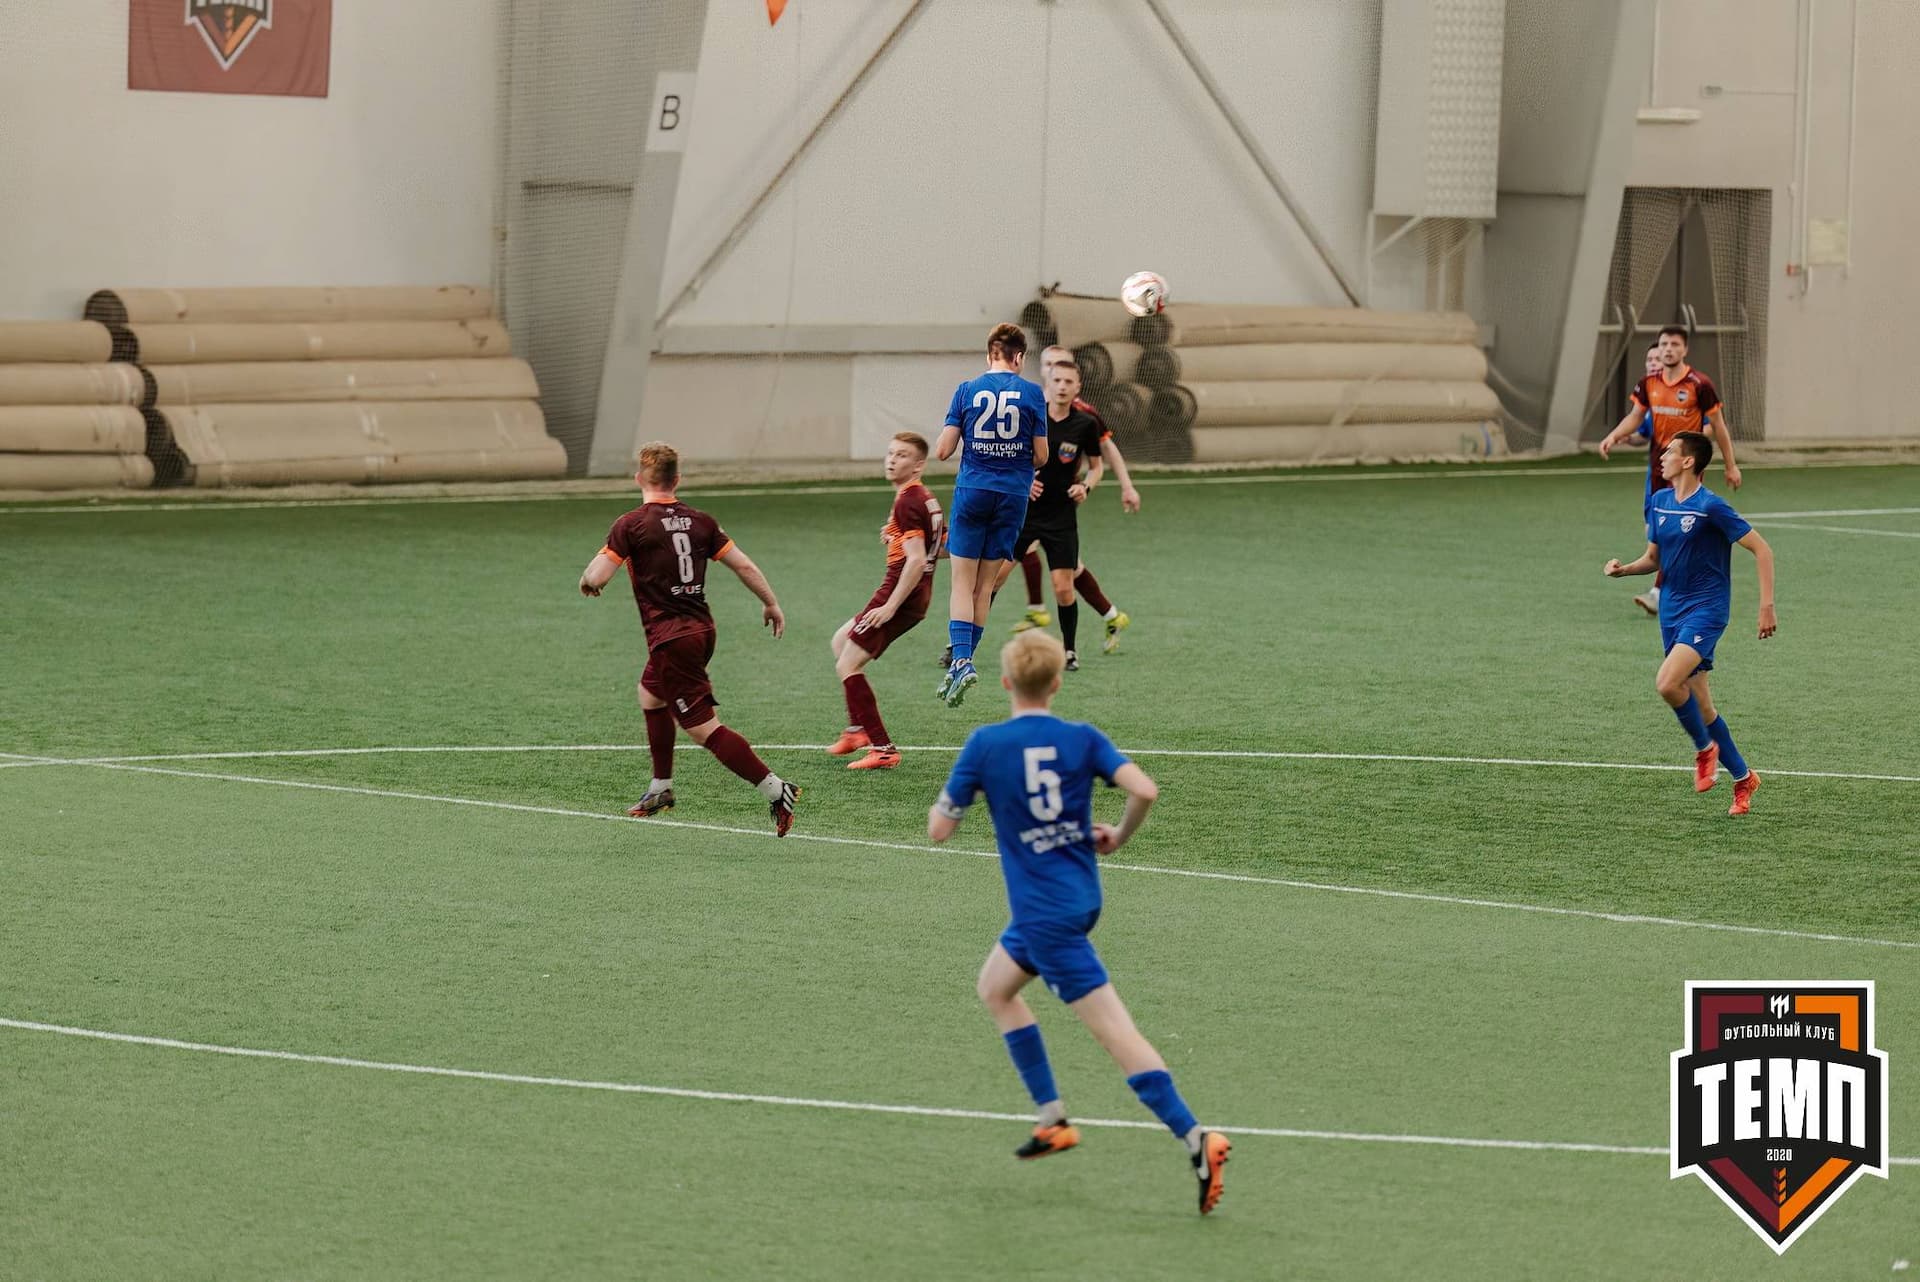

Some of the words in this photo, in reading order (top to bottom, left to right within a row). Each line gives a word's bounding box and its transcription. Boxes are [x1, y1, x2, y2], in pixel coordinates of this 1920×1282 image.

[972, 390, 1021, 440] 25
[671, 532, 695, 584] 8
[1023, 746, 1063, 821] 5
